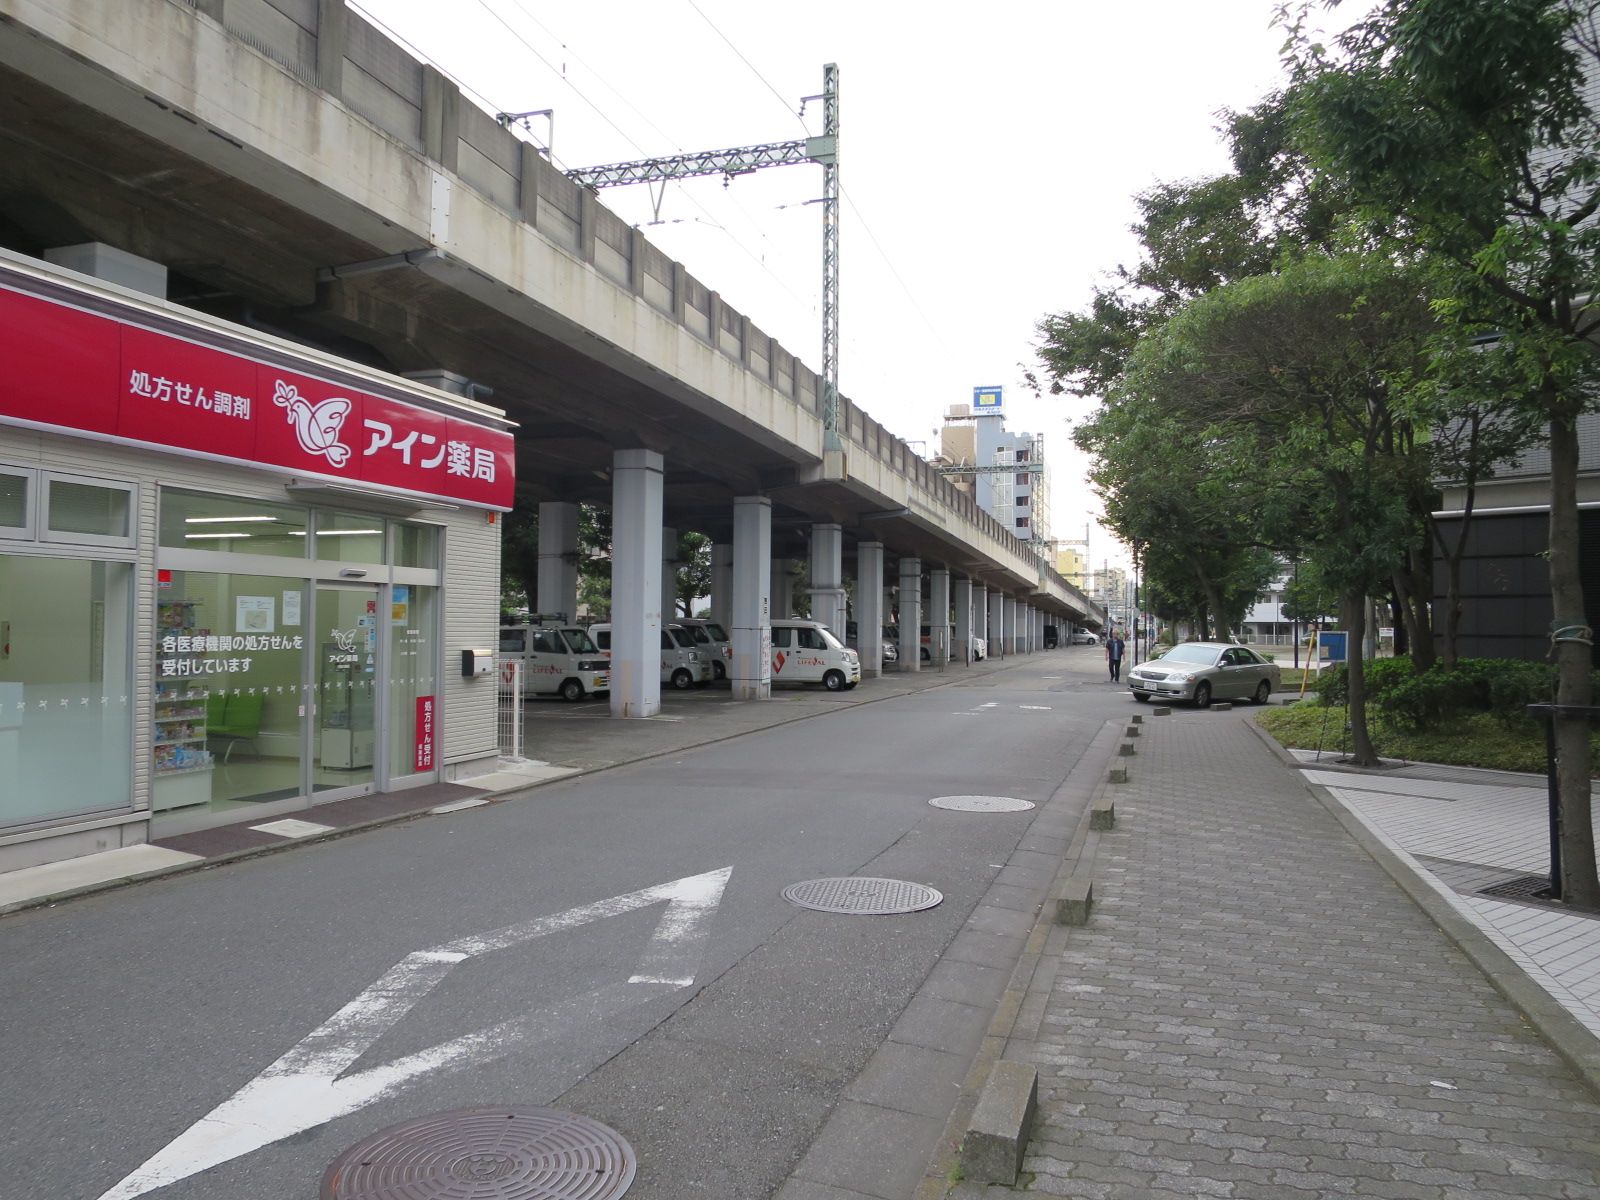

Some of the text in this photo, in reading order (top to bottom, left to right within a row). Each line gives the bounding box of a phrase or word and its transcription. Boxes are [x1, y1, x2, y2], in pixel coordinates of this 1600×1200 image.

[129, 369, 252, 421] 処方せん調剤
[363, 418, 496, 484] アイン薬局
[162, 635, 303, 653] 各医療機関の処方せんを
[162, 657, 252, 677] 受付しています
[423, 700, 432, 766] 処方せん受付
